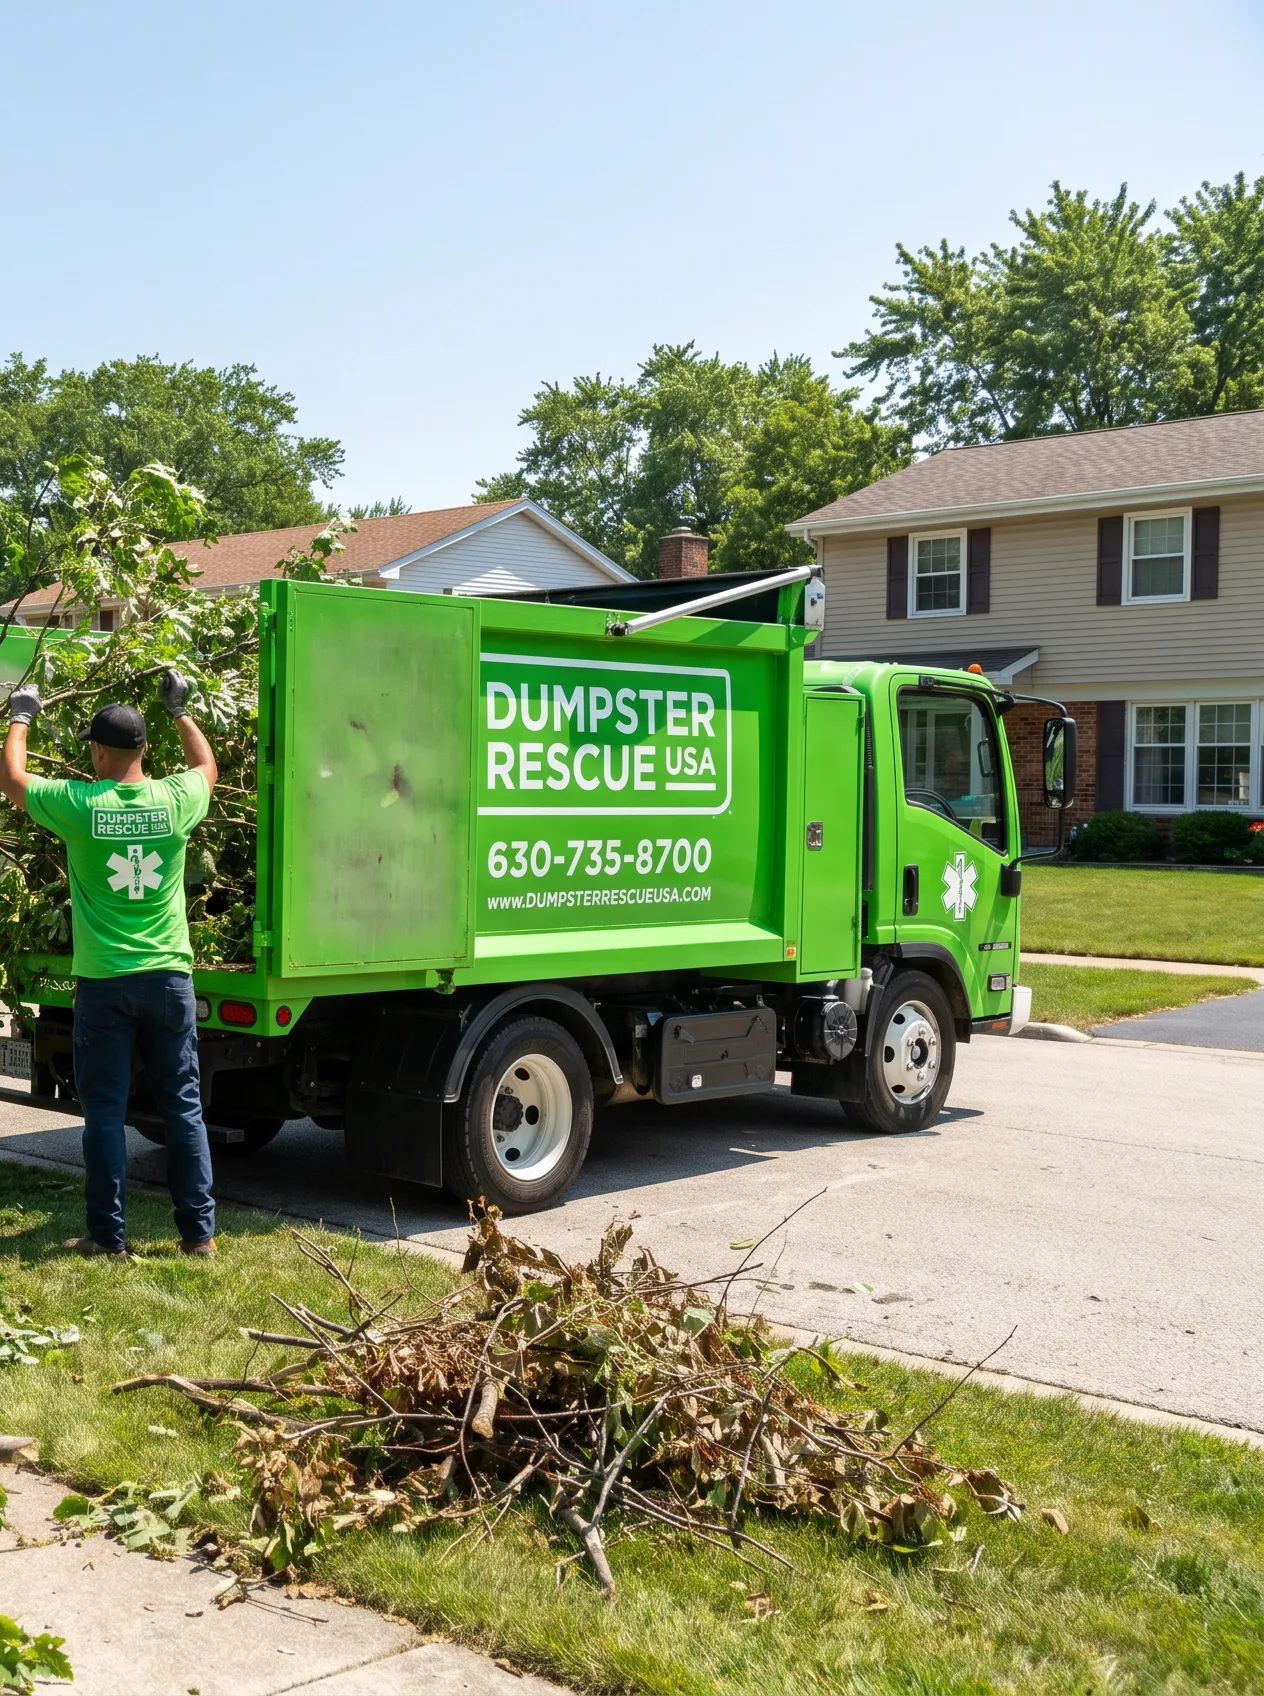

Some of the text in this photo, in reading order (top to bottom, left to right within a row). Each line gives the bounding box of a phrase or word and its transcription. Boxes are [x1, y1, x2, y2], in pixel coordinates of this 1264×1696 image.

[486, 681, 716, 737] DUMPSTER
[487, 741, 717, 791] RESCUE USA
[97, 823, 150, 835] RESCUE
[487, 837, 712, 879] 630-735-8700
